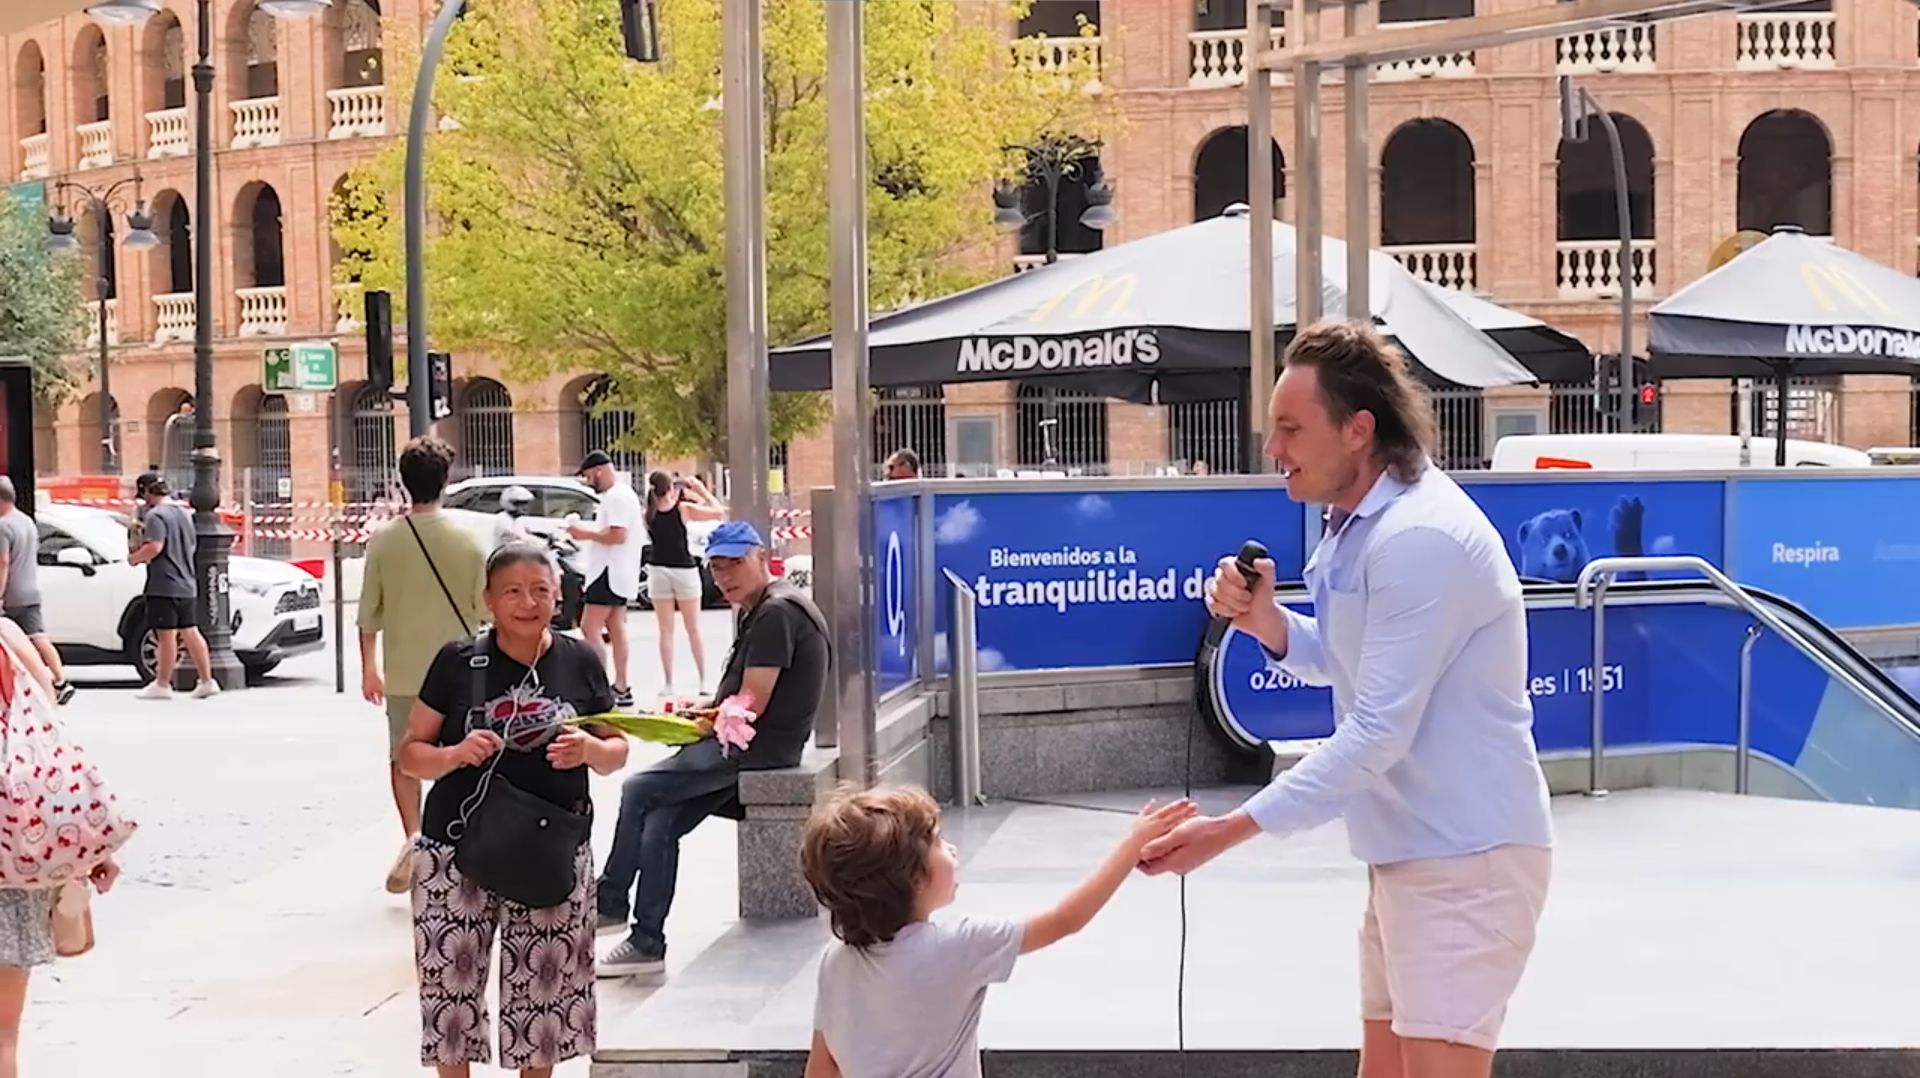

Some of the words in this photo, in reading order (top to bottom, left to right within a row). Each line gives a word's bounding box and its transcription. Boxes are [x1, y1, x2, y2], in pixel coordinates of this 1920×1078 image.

[957, 329, 1160, 372] McDonald's
[990, 546, 1100, 567] Bienvenidos
[1104, 550, 1114, 564] a
[1119, 545, 1136, 563] la
[1772, 540, 1840, 568] Respira
[975, 569, 1176, 613] tranquilidad
